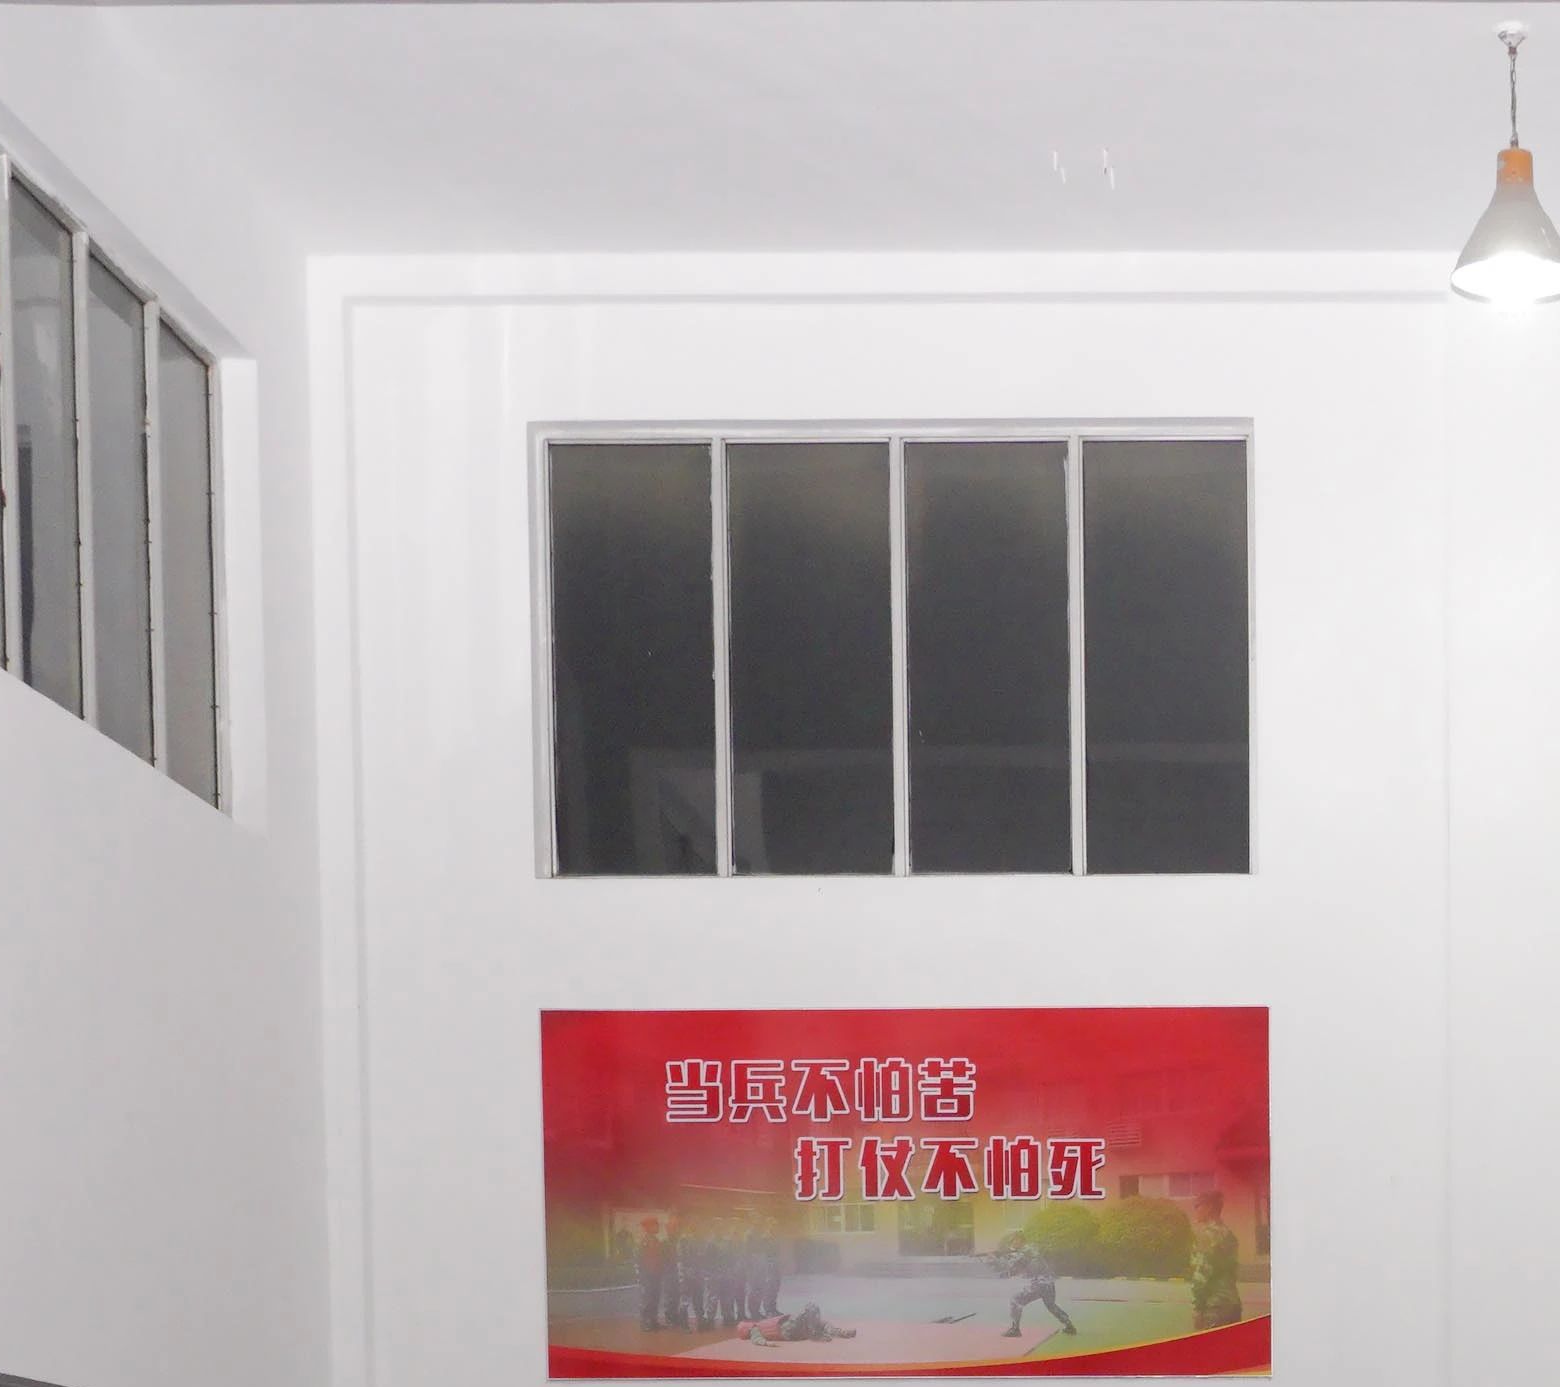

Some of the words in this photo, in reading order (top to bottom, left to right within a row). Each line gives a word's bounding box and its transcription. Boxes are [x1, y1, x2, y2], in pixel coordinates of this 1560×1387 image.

[664, 1057, 977, 1124] 当兵不怕苦
[794, 1137, 1106, 1200] 打仗不怕死
